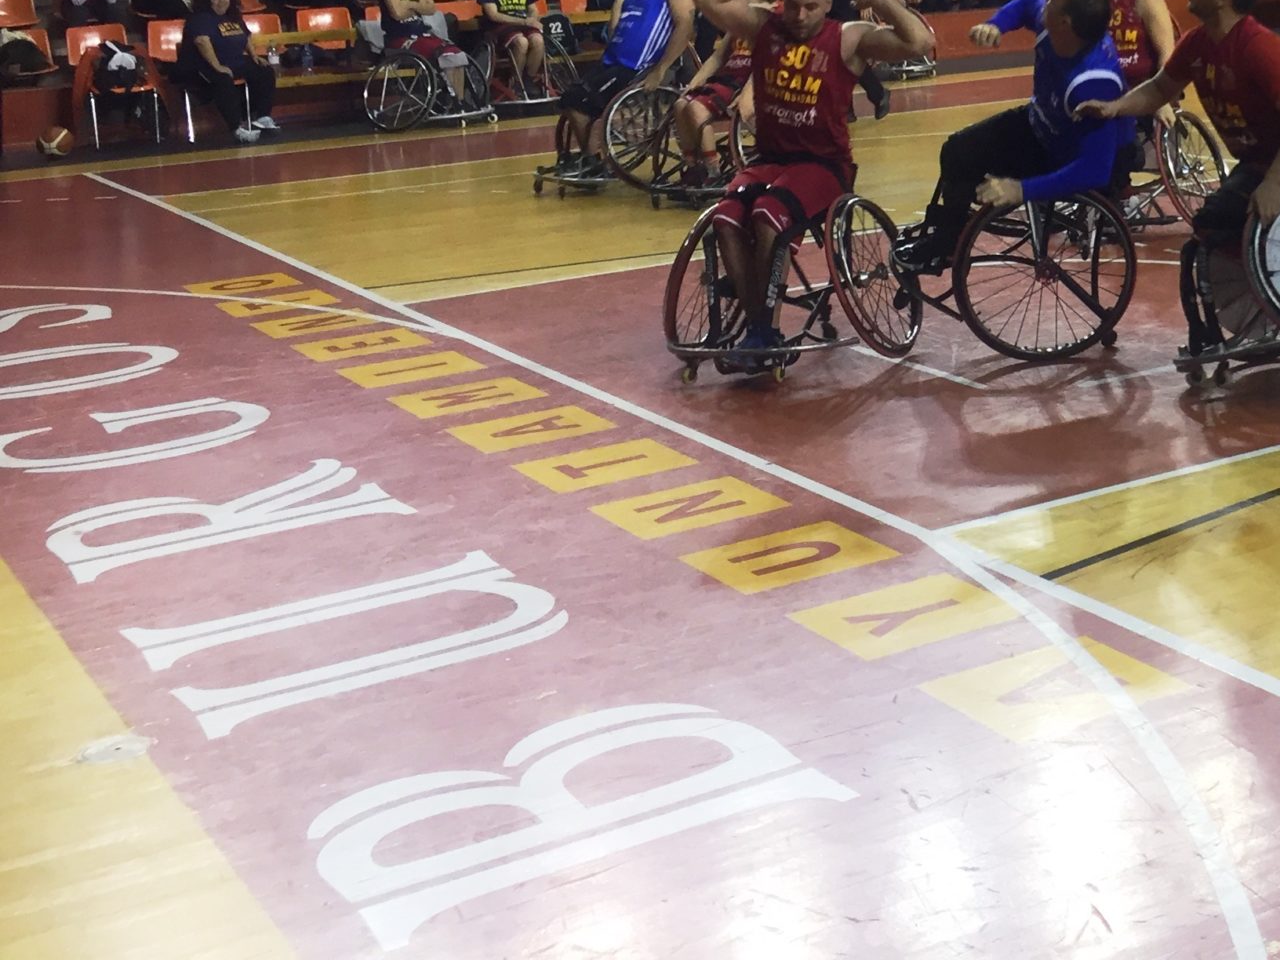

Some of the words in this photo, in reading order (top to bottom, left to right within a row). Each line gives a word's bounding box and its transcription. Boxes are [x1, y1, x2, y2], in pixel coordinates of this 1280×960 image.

[549, 21, 564, 33] 22
[780, 44, 811, 70] 30
[764, 67, 822, 95] UCAM
